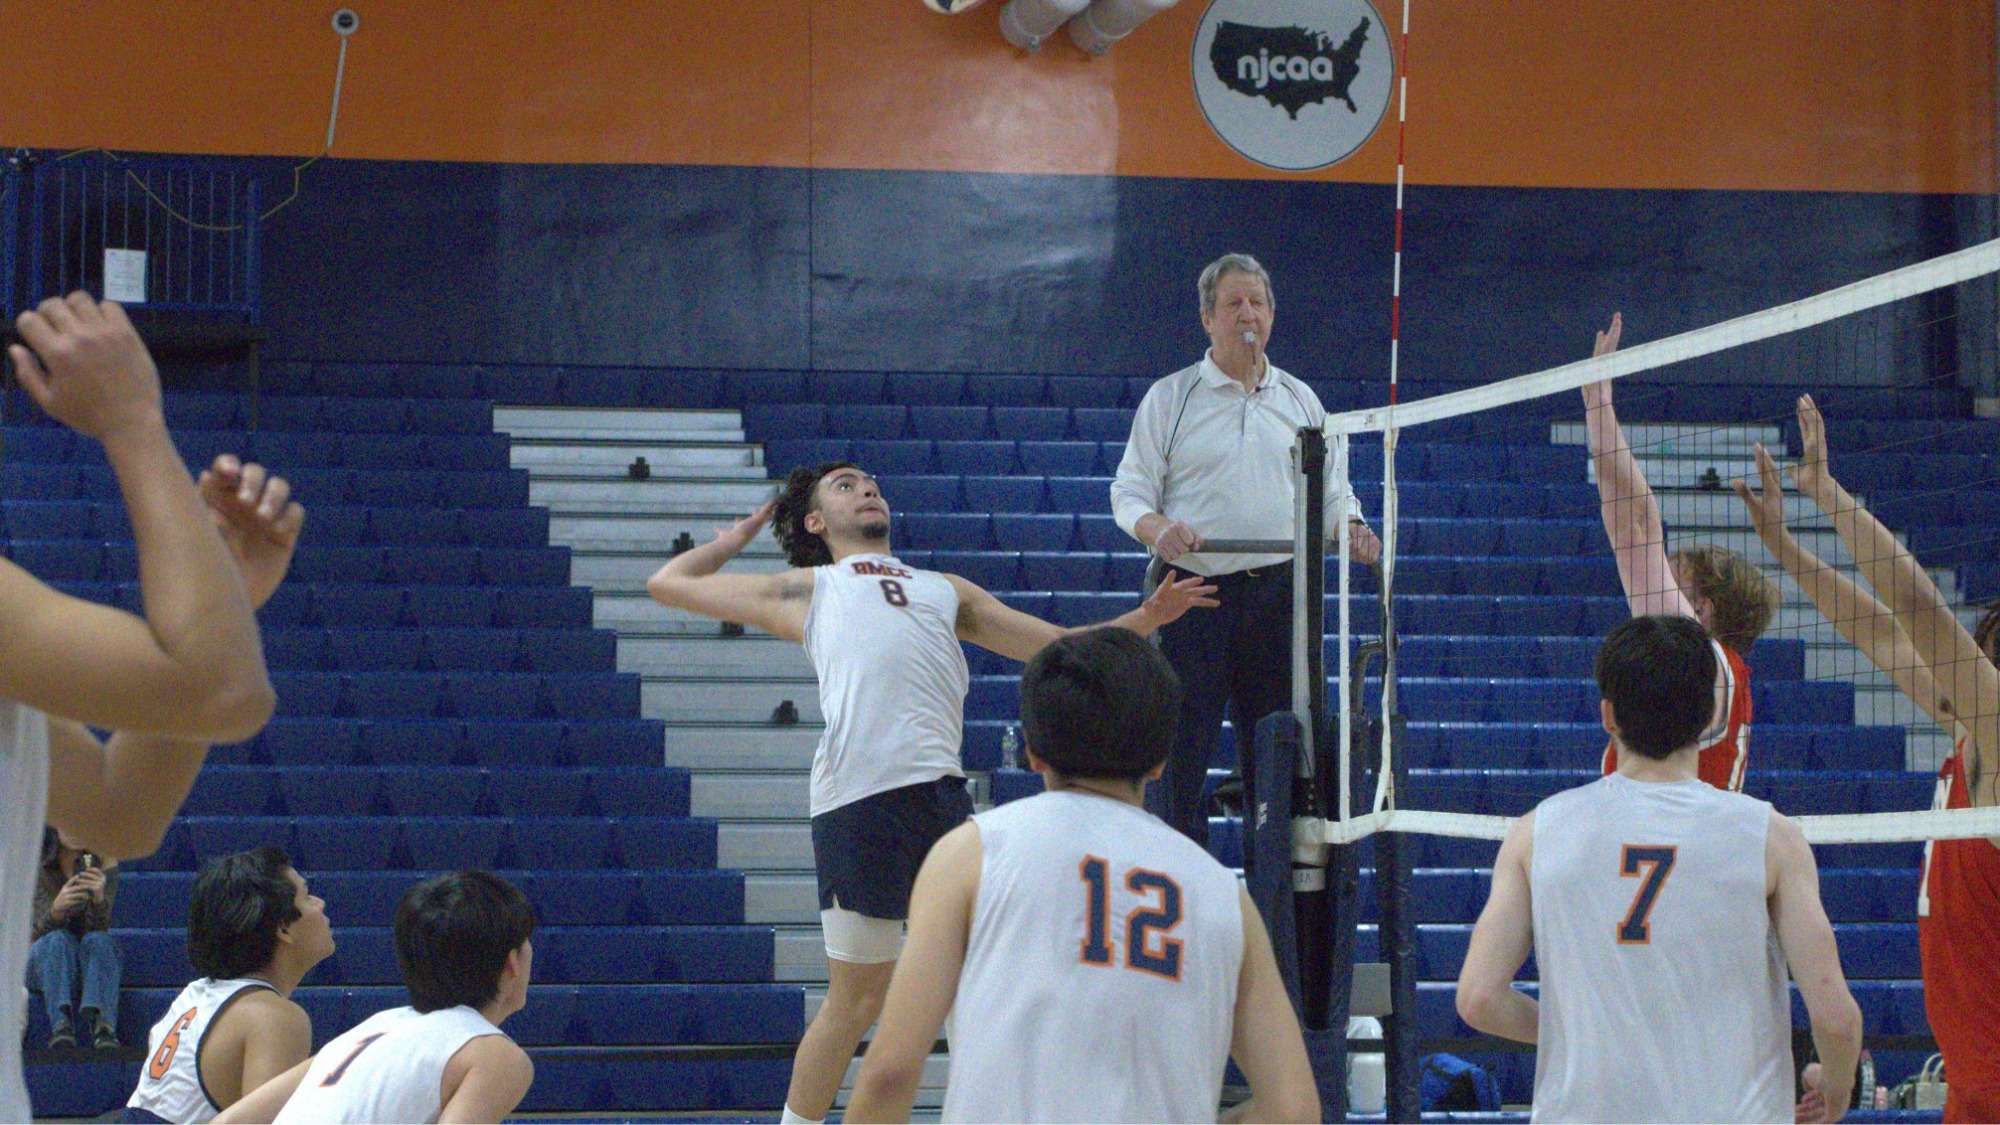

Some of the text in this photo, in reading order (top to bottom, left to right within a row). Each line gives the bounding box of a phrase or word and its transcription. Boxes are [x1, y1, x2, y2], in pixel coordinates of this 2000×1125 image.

[1237, 47, 1333, 89] njcaa
[879, 579, 909, 608] 8
[1079, 854, 1184, 982] 12
[1617, 844, 1678, 945] 7
[149, 1006, 198, 1080] 6
[318, 1031, 388, 1088] 1
